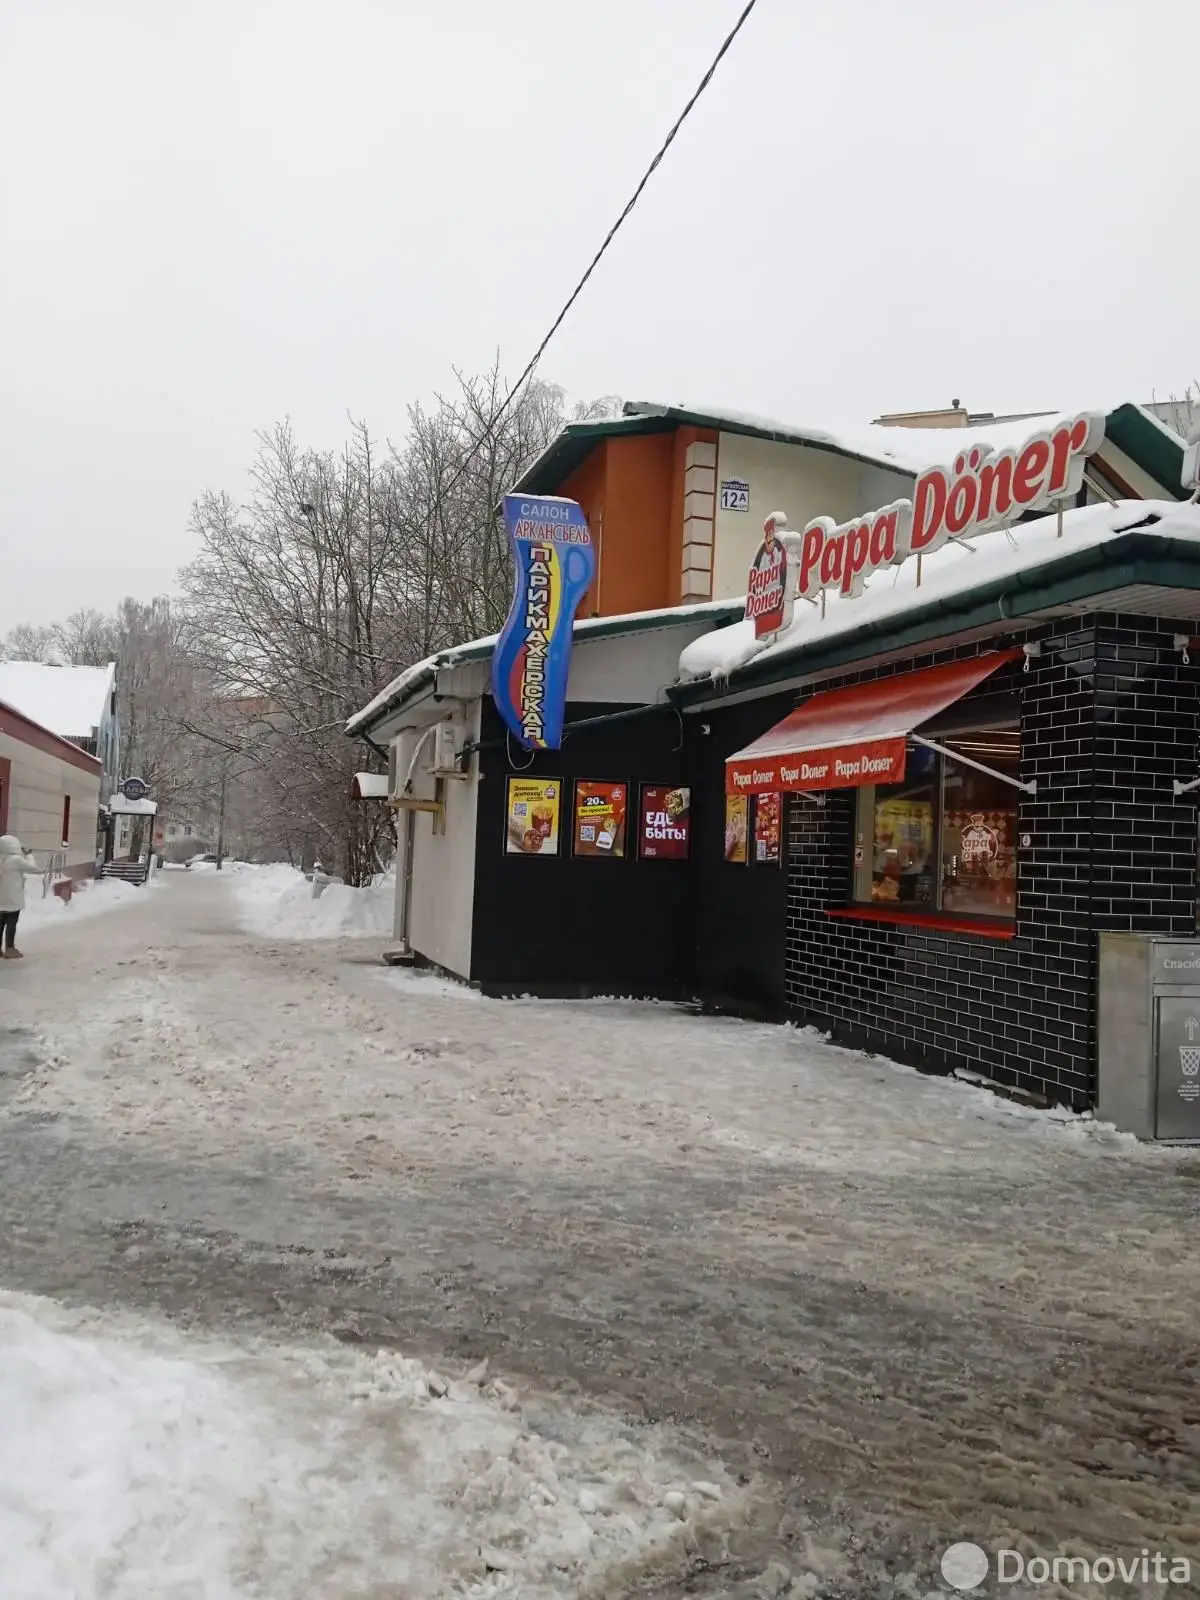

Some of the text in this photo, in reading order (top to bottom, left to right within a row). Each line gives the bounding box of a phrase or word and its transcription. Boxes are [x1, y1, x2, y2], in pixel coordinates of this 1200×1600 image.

[520, 503, 569, 520] САЛОН
[799, 419, 1088, 594] Papa Döner
[513, 519, 591, 545] АРКАНСЬЕЛЬ
[748, 563, 780, 593] Papa
[522, 546, 553, 740] ПАРИКМАХЕРСКАЯ
[780, 763, 829, 784] Papa Doner
[835, 755, 894, 779] Papa Doner
[733, 771, 752, 788] Papa
[645, 827, 686, 840] БЫТЬ!
